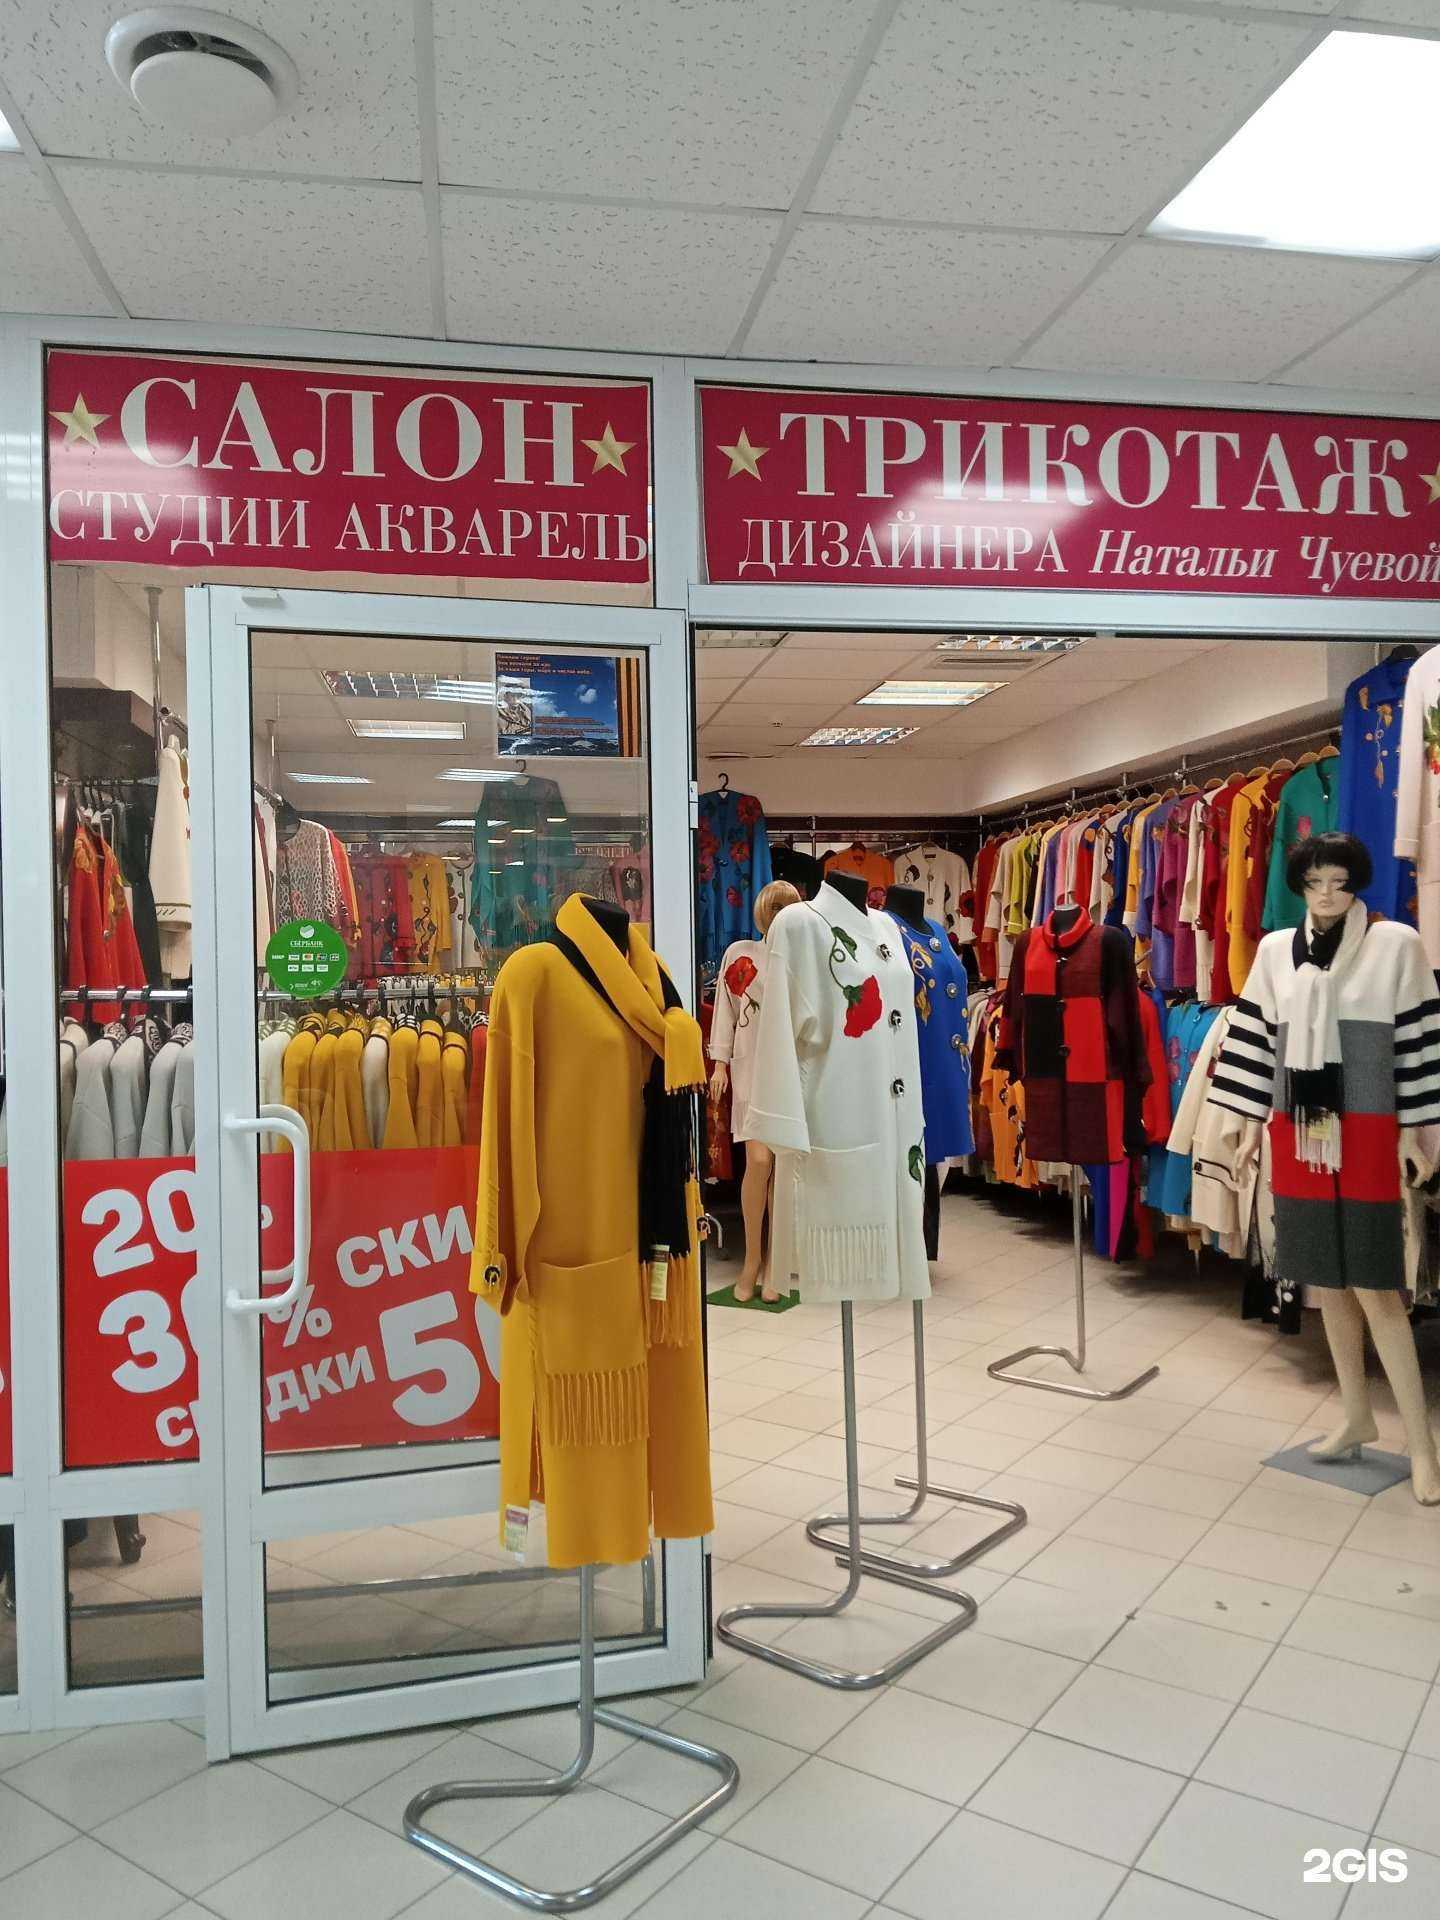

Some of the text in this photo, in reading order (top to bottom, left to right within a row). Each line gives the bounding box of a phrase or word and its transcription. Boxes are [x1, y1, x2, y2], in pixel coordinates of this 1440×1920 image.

[120, 377, 584, 487] САЛОН
[779, 412, 1411, 518] ТРИКОТАЖ
[49, 489, 648, 562] СТУДИИ АКВАРЕЛЬ
[738, 509, 1440, 593] ДИЗАЙНЕРА Натальи Чуевой
